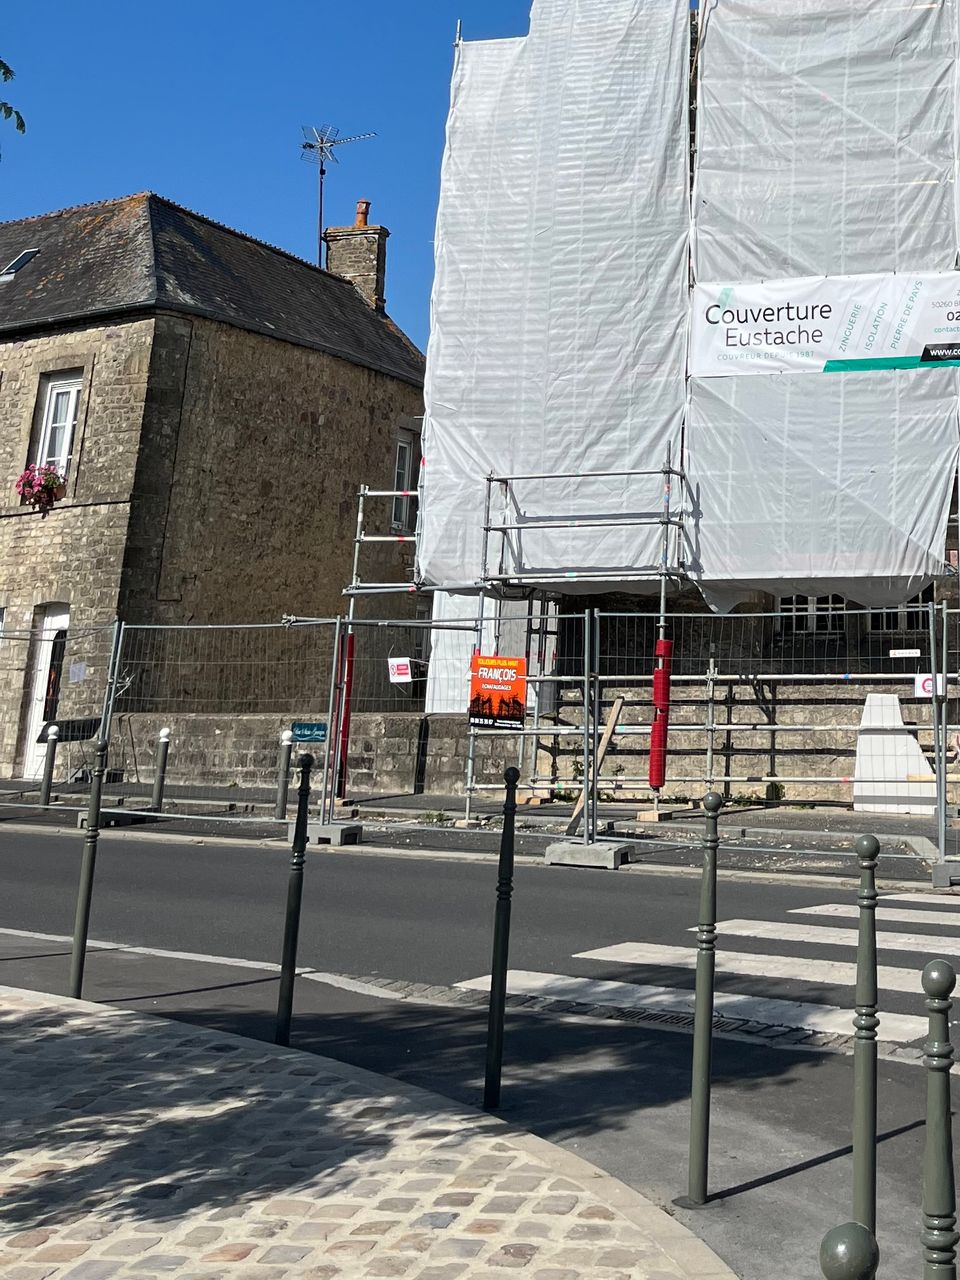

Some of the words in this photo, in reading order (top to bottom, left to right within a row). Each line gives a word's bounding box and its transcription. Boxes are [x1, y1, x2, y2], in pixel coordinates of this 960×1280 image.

[908, 280, 923, 303] PAYS
[705, 302, 832, 325] Couverture
[903, 303, 914, 317] DE
[725, 325, 823, 347] Eustache
[839, 303, 862, 352] ZINGUERIE
[864, 302, 888, 351] ISOLATION
[890, 316, 908, 350] PIERRE
[717, 350, 761, 361] COUVREUR
[797, 350, 815, 358] 1987
[478, 667, 517, 684] FRANÇOIS
